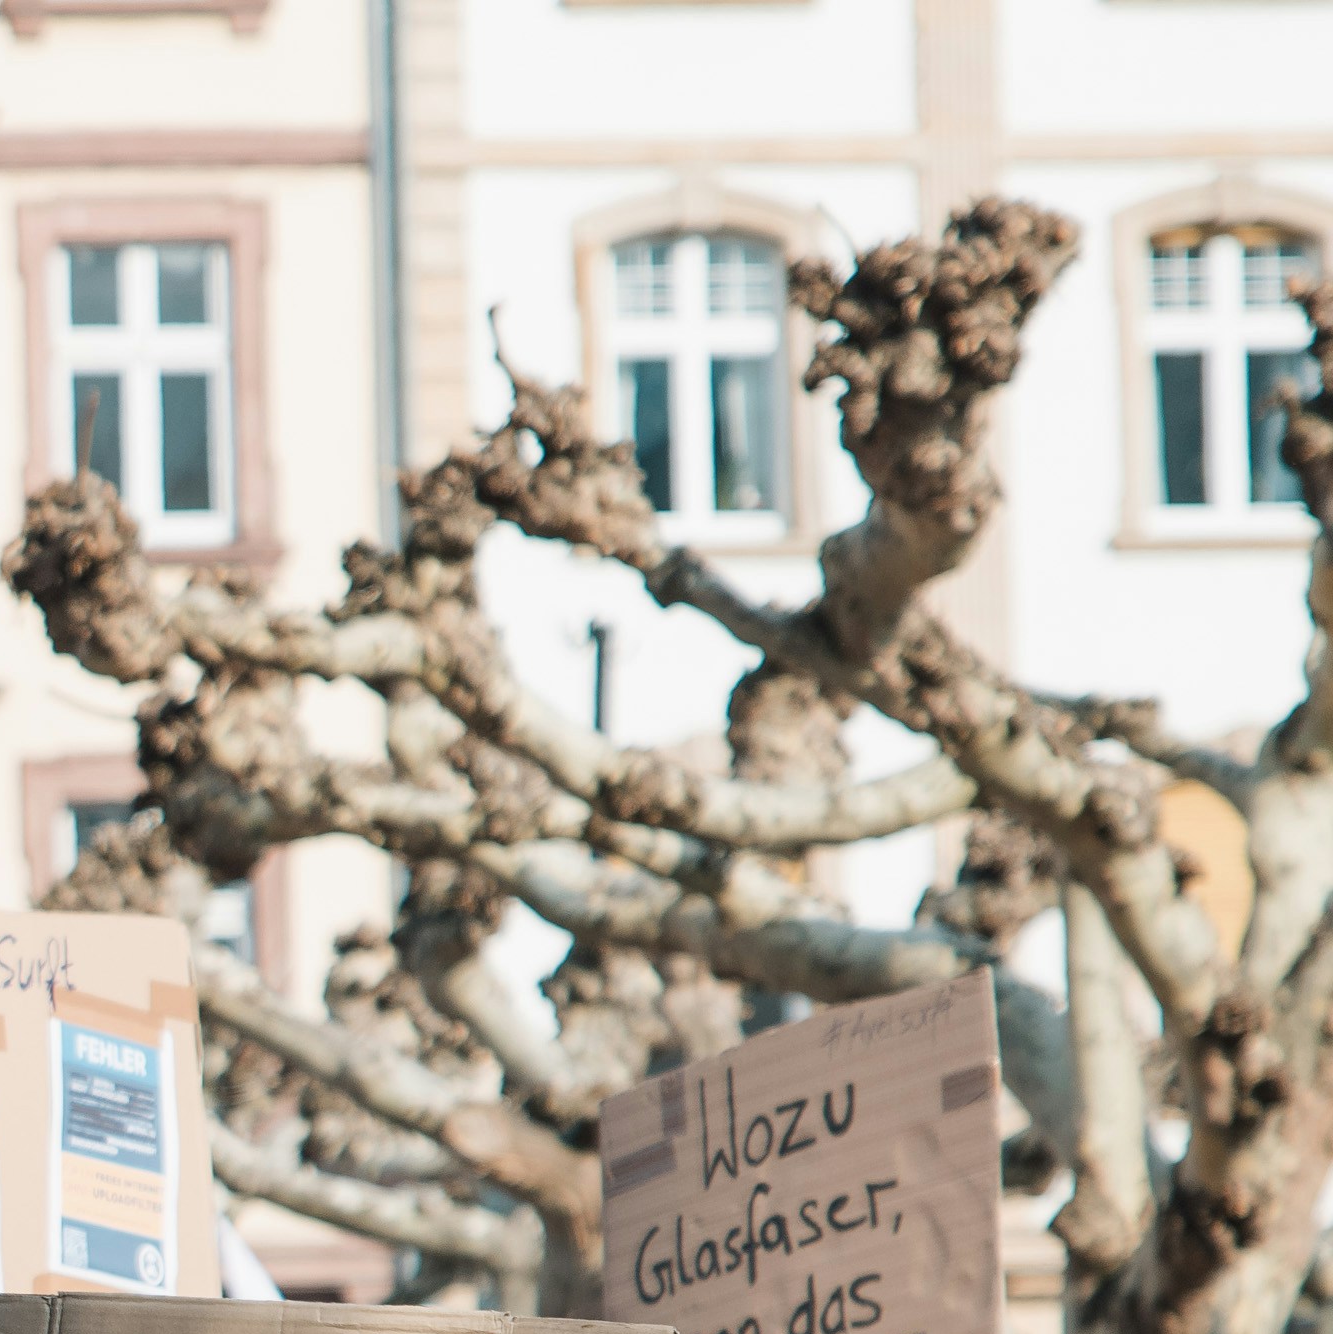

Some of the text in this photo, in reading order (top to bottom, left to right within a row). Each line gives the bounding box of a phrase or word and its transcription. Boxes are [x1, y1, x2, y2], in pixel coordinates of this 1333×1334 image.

[75, 1033, 148, 1079] FEHLER
[699, 1066, 856, 1191] Wozu
[634, 1178, 904, 1307] Glasfaser,
